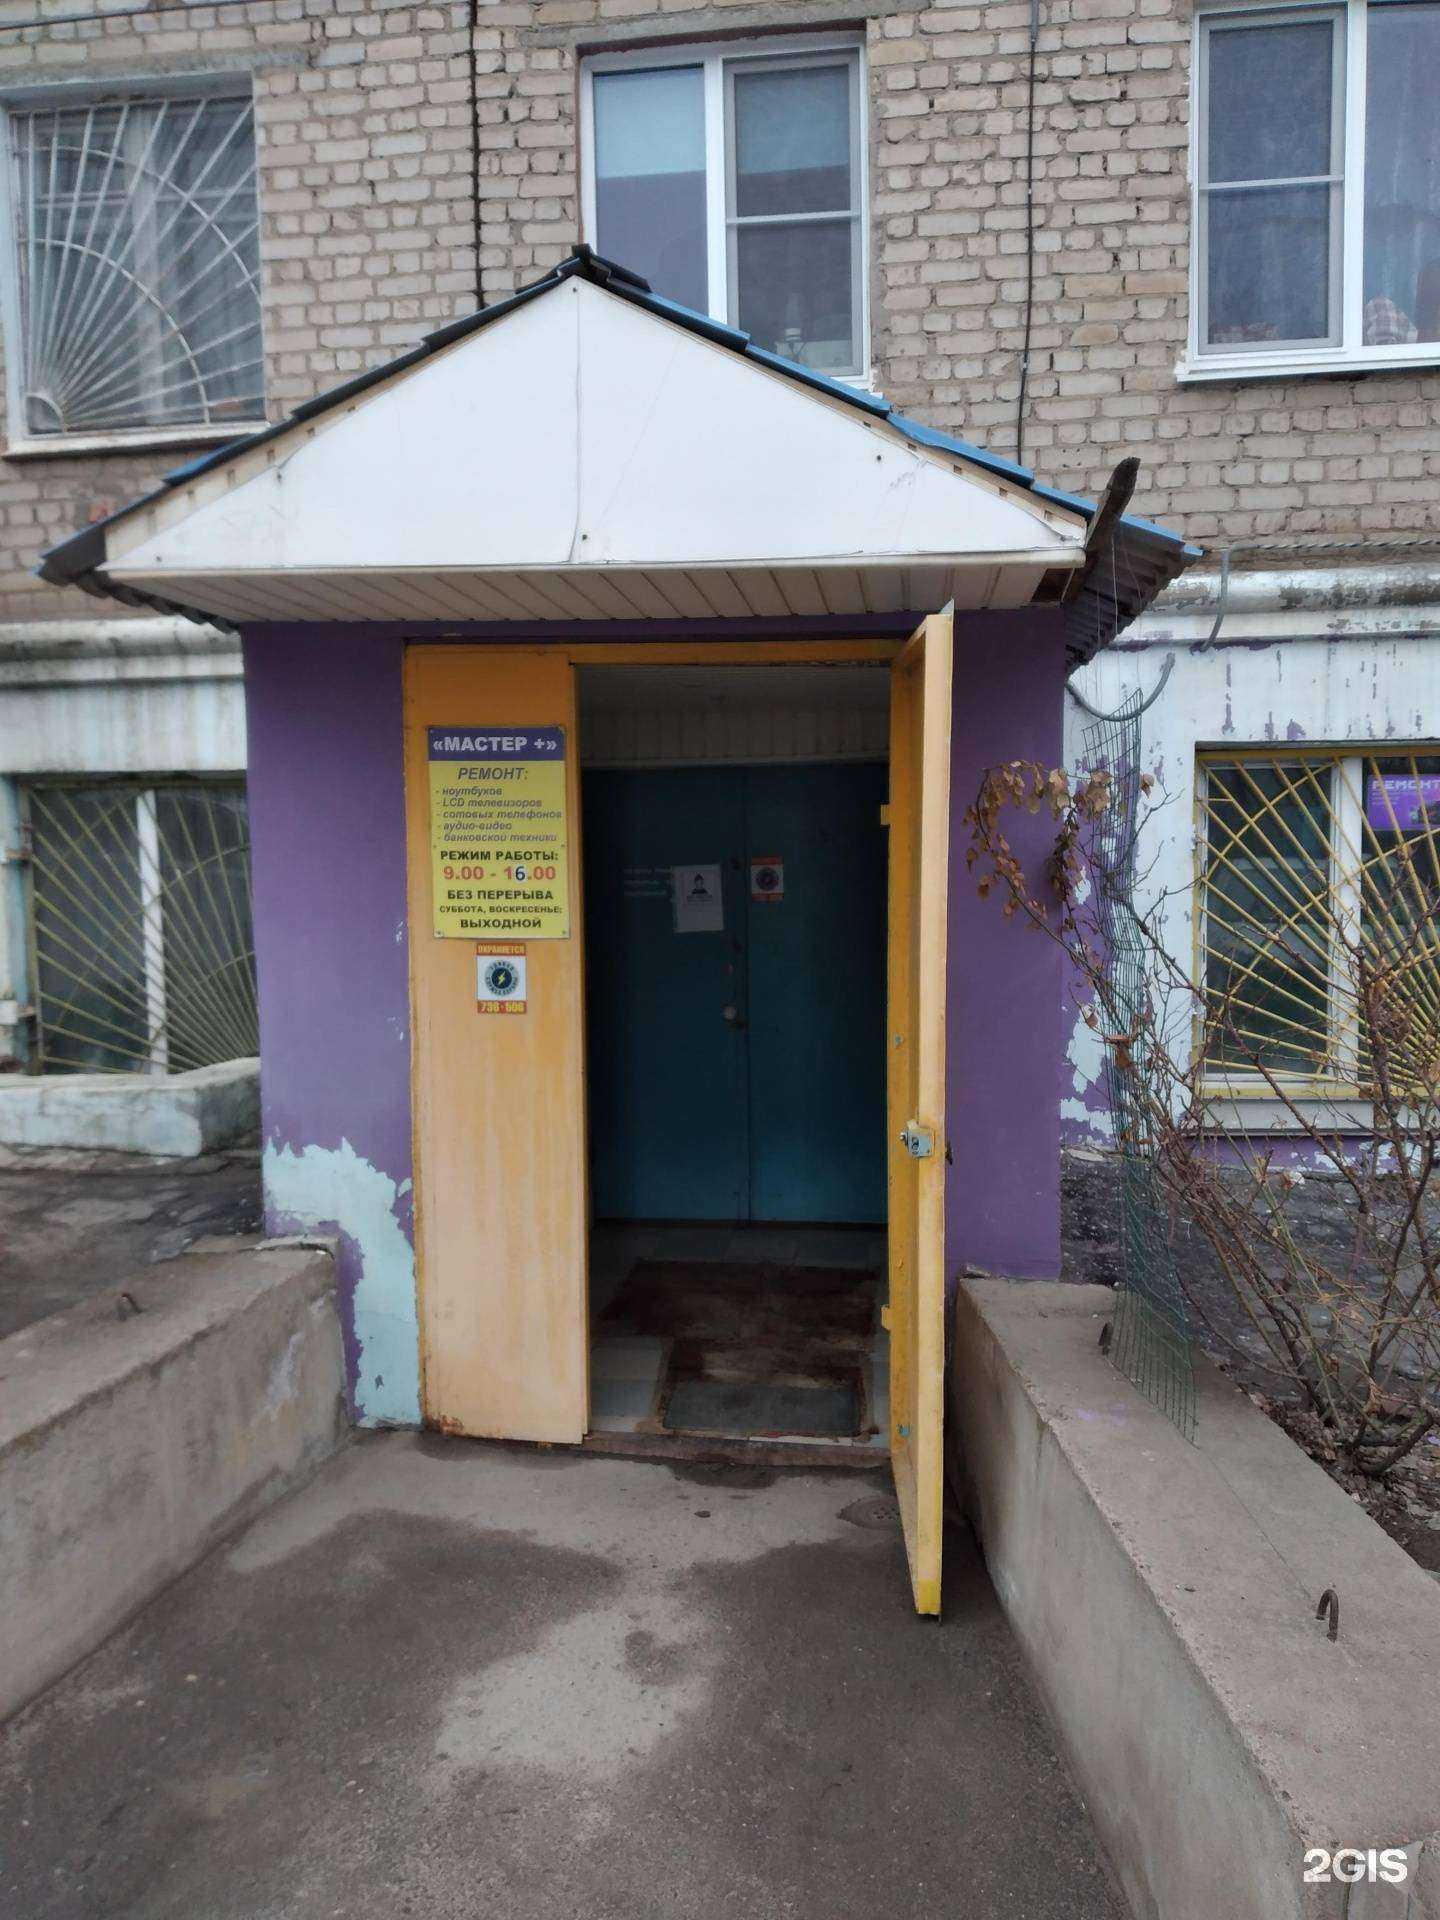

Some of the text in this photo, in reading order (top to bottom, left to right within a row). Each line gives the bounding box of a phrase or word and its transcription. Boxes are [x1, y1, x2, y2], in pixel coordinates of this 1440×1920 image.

[433, 736, 528, 752] «МАСТЕР
[457, 767, 529, 780] РЕМОНТ:
[442, 785, 503, 798] ноутбуков
[442, 797, 465, 808] LCD
[467, 798, 543, 809] телевизоров
[443, 810, 494, 819] сотовых
[496, 808, 562, 821] телефонов
[443, 821, 512, 833] аудио-видео
[443, 832, 507, 842] банковской
[509, 834, 557, 842] техники
[440, 850, 559, 861] РЕЖИМ РАБОТЫ:
[443, 865, 485, 880] 9.00
[503, 865, 557, 882] 16.00
[447, 889, 554, 900] БЕЗ ПЕРЕРЫВА
[439, 905, 487, 914] СУББОТА,
[460, 917, 542, 929] ВЫХОДНОЙ
